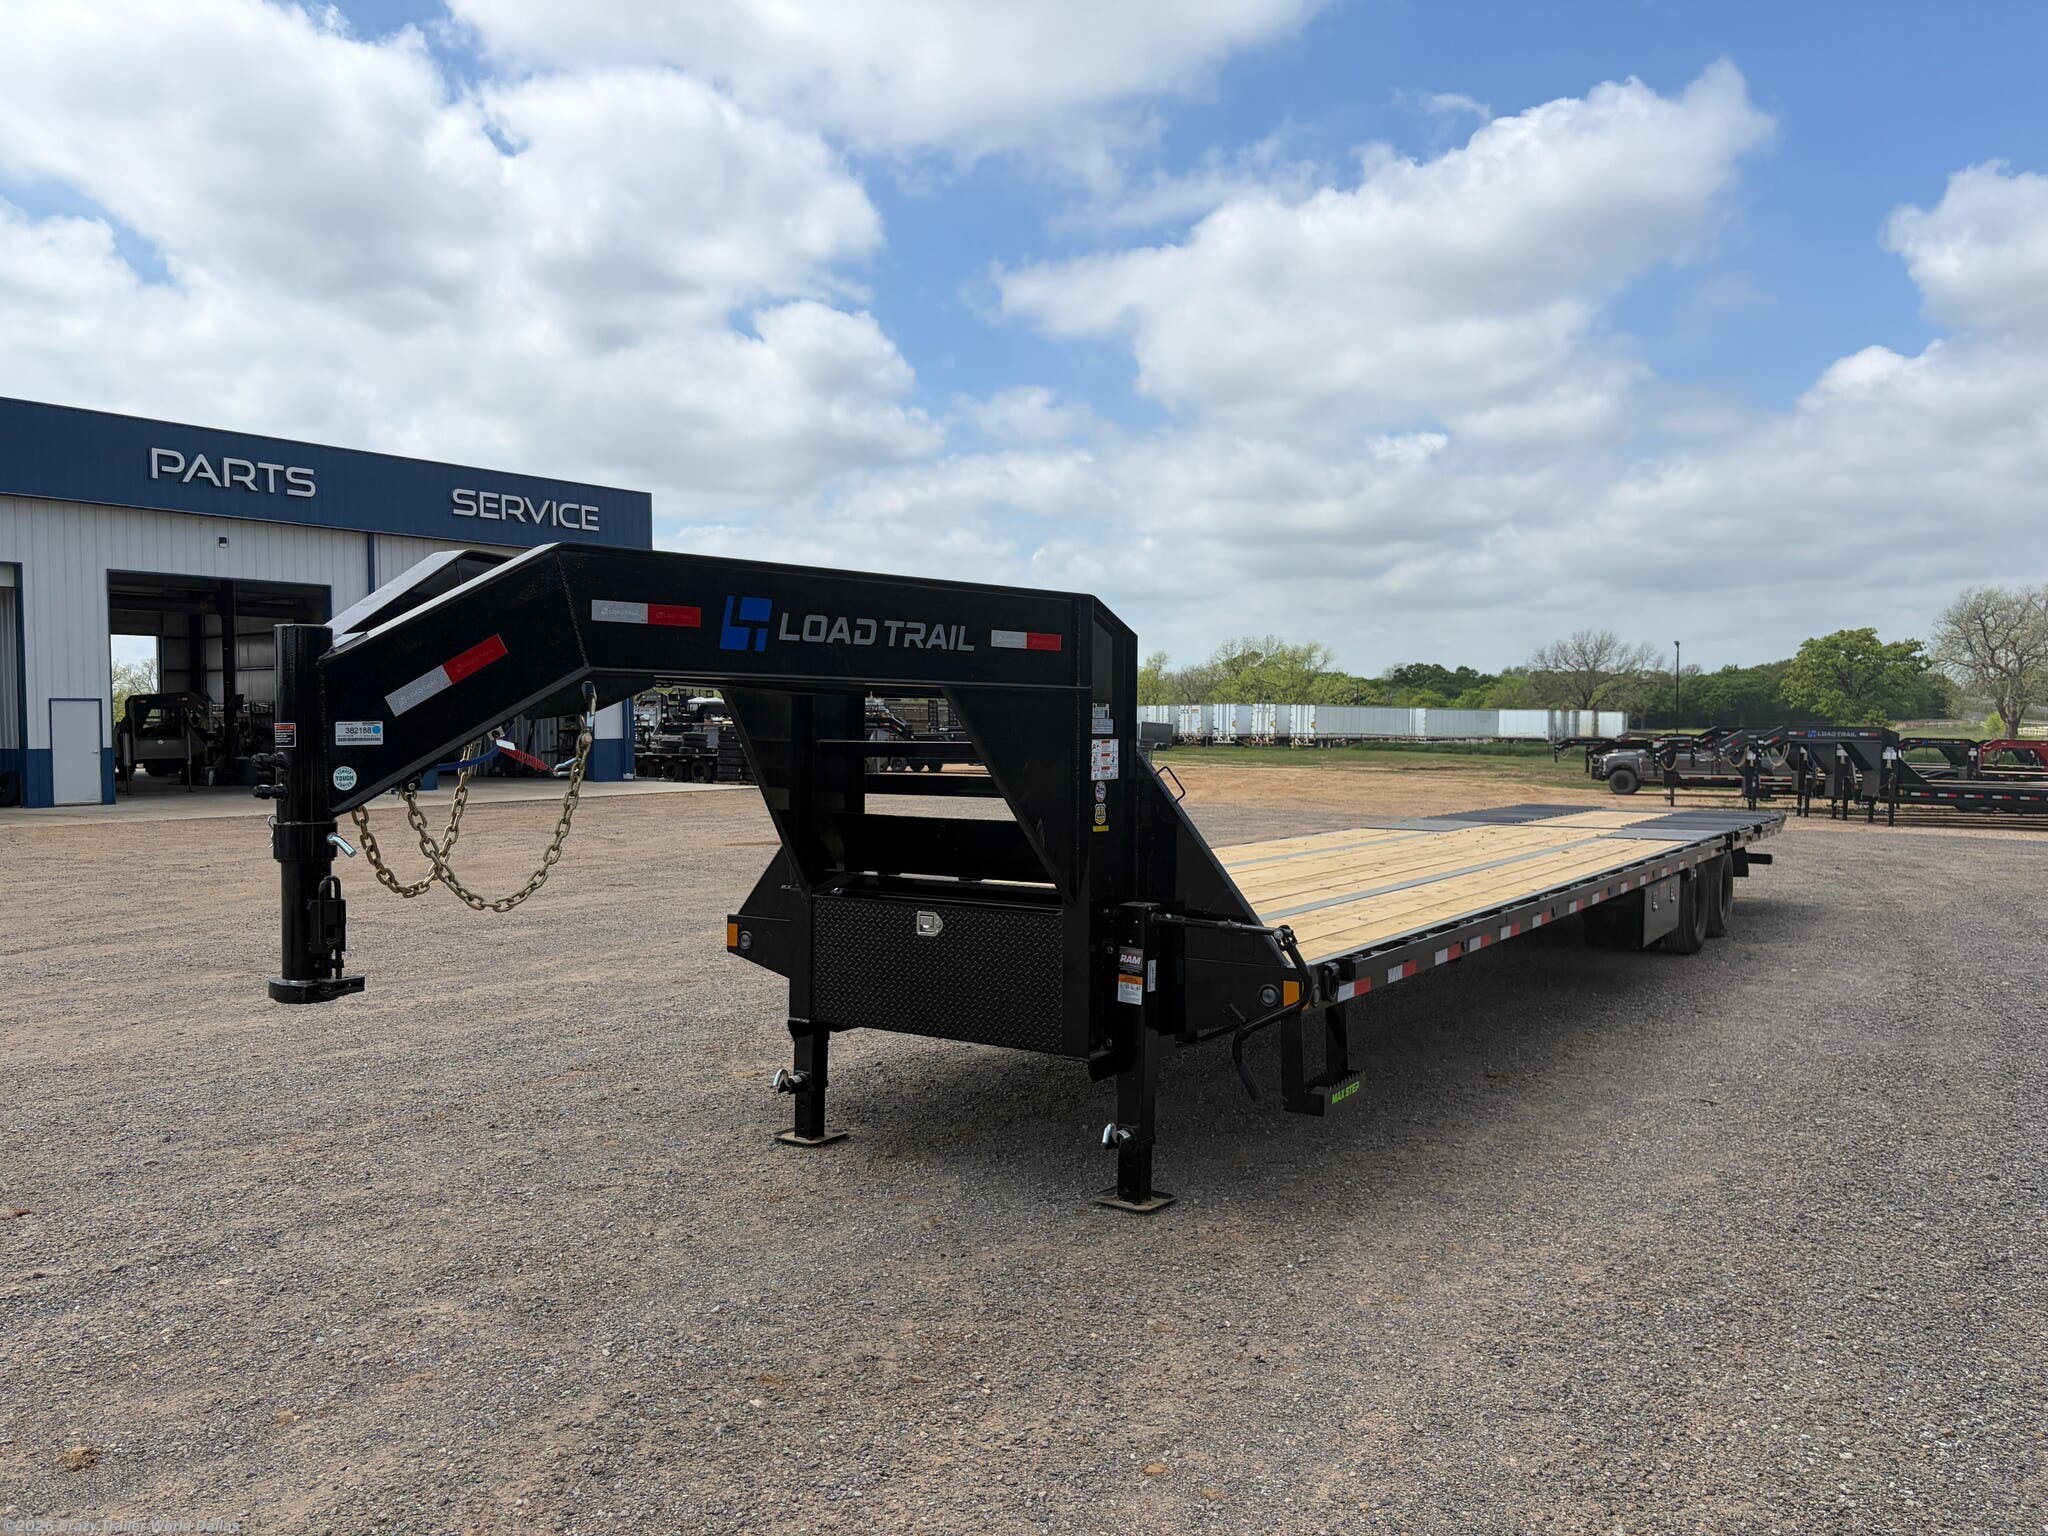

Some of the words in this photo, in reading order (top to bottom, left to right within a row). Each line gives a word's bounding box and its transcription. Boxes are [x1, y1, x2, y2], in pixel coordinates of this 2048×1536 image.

[150, 447, 317, 498] PARTS
[452, 488, 600, 531] SERVICE
[778, 612, 878, 646] LOAD
[884, 620, 976, 651] TRAIL
[1120, 954, 1141, 965] RAM
[1331, 1088, 1345, 1105] MAX
[1346, 1080, 1360, 1097] STEP
